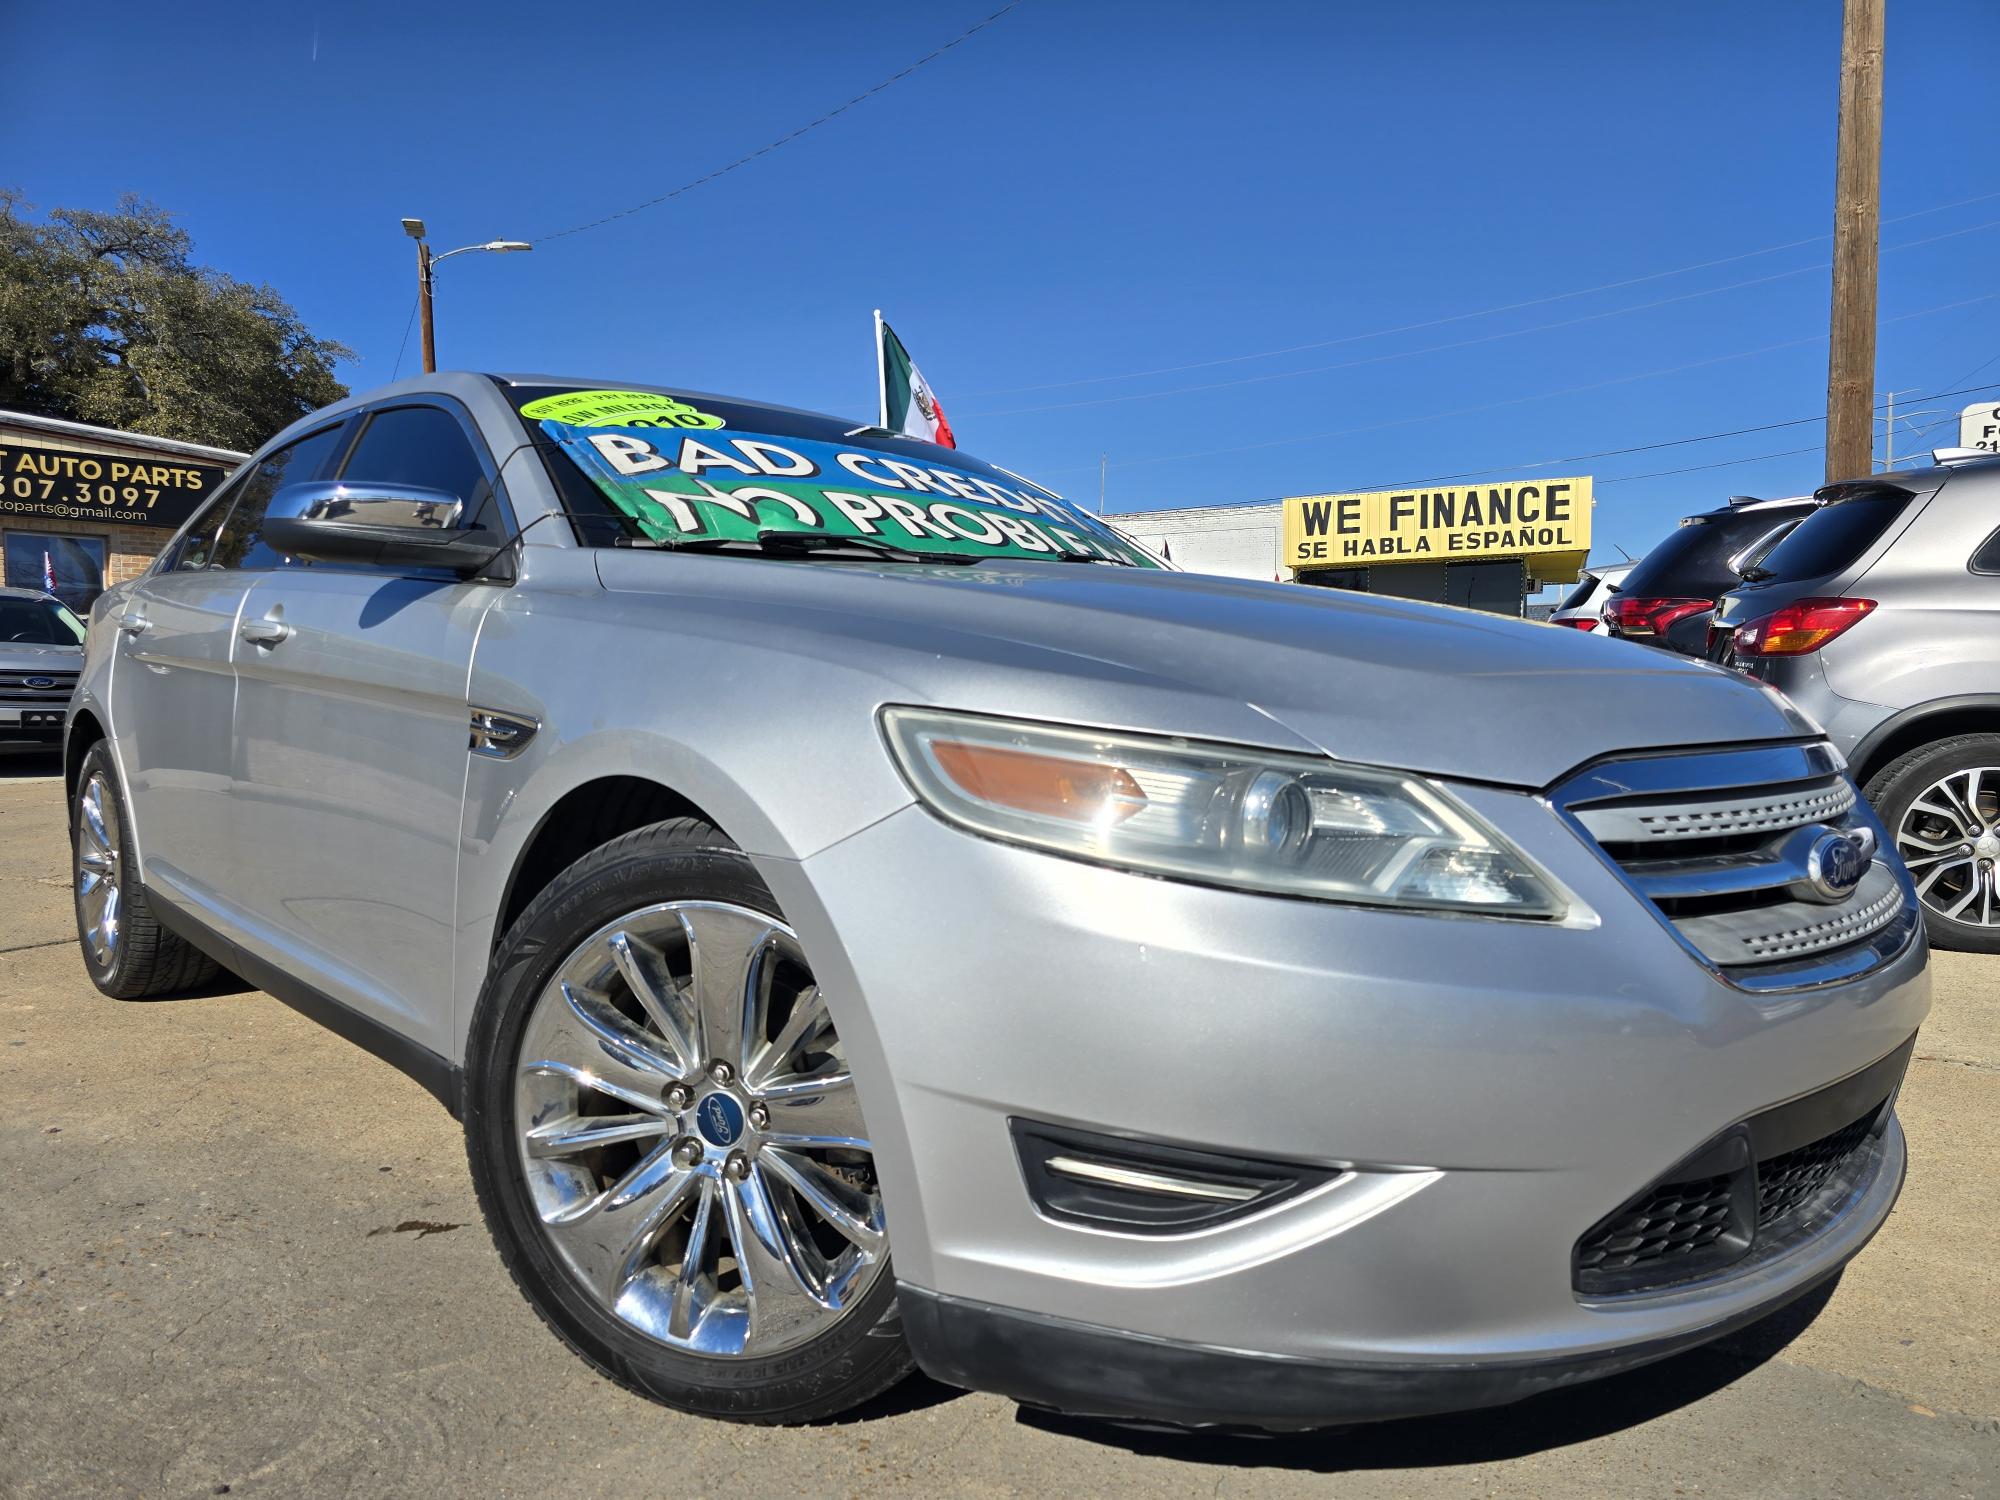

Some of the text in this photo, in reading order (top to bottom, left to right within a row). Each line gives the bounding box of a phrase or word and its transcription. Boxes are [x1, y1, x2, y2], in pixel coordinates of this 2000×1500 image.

[599, 403, 683, 416] MILEAGE
[600, 413, 707, 428] 010
[15, 453, 102, 480] AUTO
[111, 462, 203, 490] PARTS
[586, 434, 821, 477] BAD
[1301, 484, 1571, 537] WE FINANCE
[1297, 526, 1573, 559] SE HABLA ESPAÑOL
[711, 1105, 729, 1134] Ford
